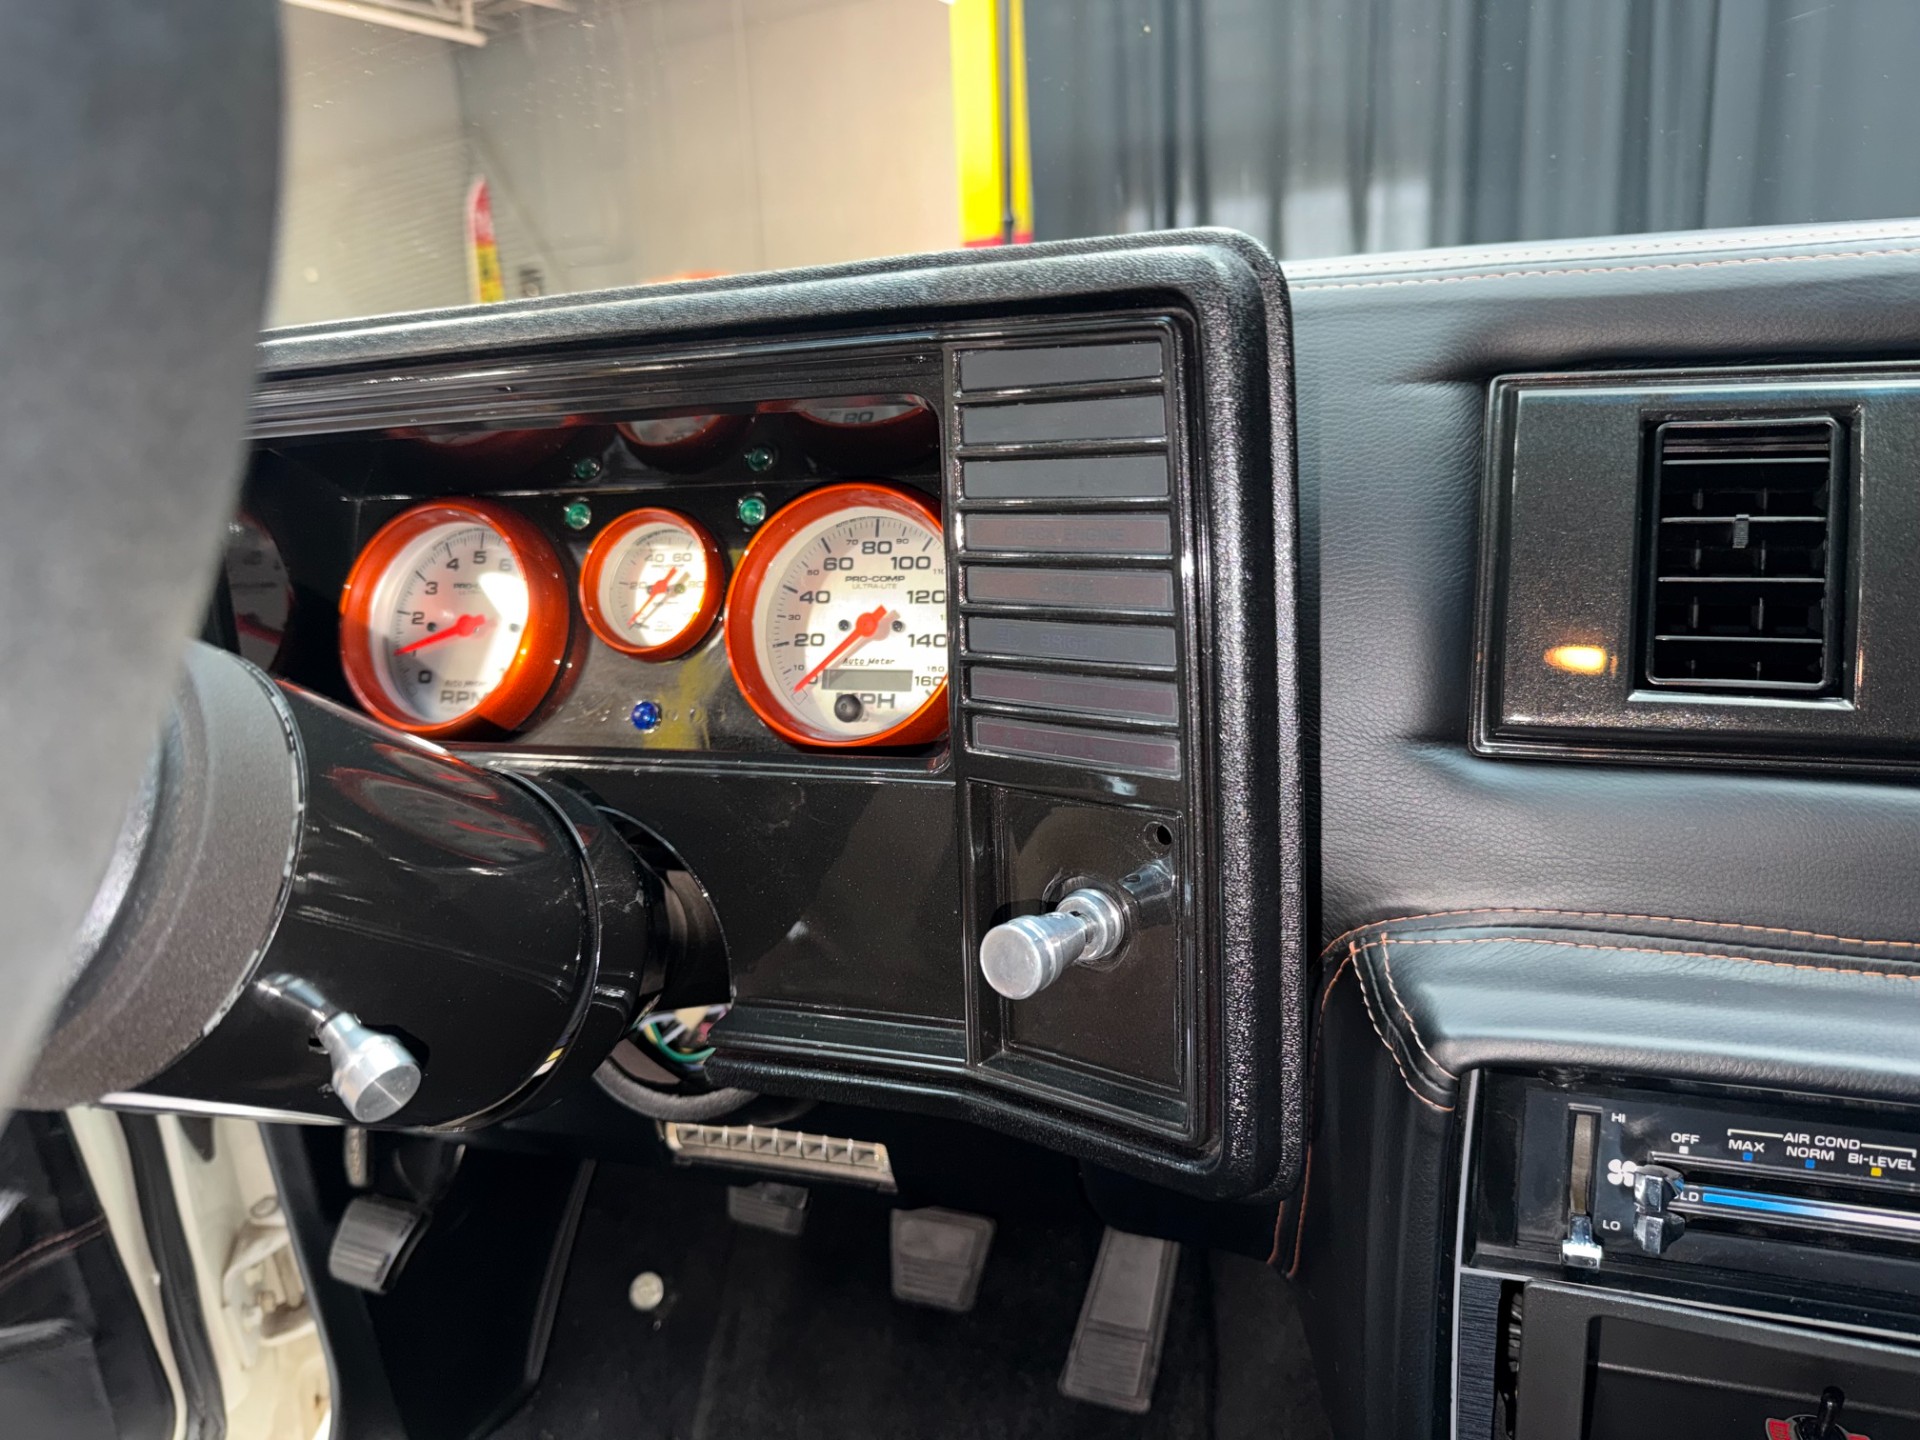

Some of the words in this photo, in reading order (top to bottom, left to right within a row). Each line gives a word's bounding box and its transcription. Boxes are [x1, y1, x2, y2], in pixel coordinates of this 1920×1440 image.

[861, 541, 893, 554] 80
[473, 550, 487, 564] 5
[672, 552, 692, 562] 60
[823, 557, 854, 571] 60
[890, 556, 931, 570] 100
[446, 558, 459, 572] 4
[499, 558, 512, 572] 6
[425, 581, 438, 595] 3
[799, 590, 831, 604] 40
[907, 590, 946, 604] 120
[411, 611, 425, 625] 2
[794, 633, 826, 647] 20
[907, 633, 947, 648] 140
[418, 670, 432, 684] 0
[914, 676, 943, 687] 160
[836, 692, 896, 709] PH
[1611, 1113, 1626, 1124] HI
[1670, 1132, 1700, 1145] OFF
[1782, 1132, 1811, 1145] AIR
[1814, 1135, 1861, 1150] COND
[1728, 1139, 1765, 1153] MAX
[1786, 1146, 1835, 1161] NORM
[1847, 1154, 1916, 1171] BI-LEVEL
[1602, 1219, 1621, 1231] LO
